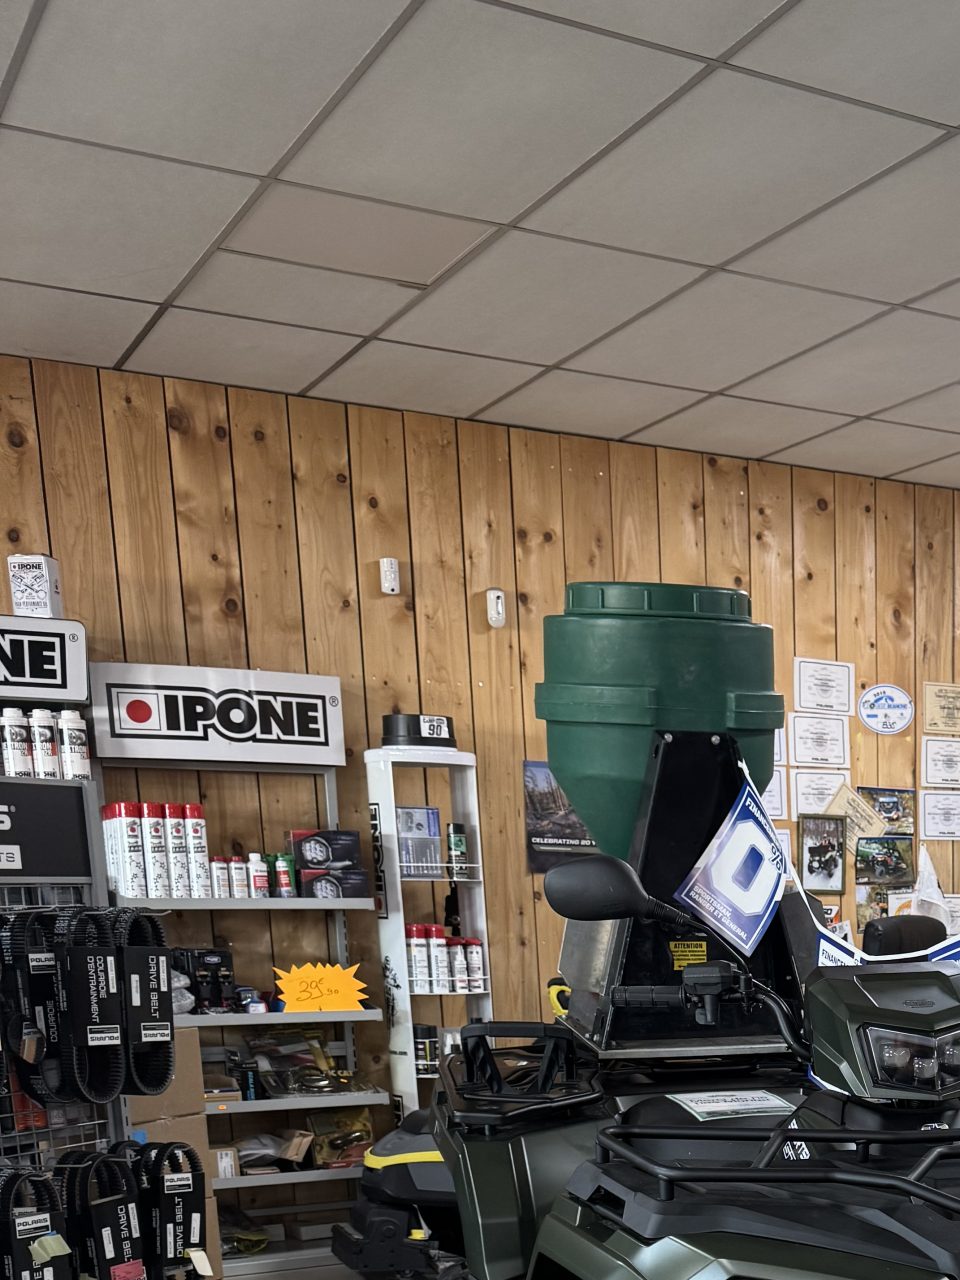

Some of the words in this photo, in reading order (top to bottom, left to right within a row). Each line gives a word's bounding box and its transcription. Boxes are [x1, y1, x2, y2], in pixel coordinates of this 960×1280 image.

[164, 694, 321, 739] IPONE
[428, 723, 443, 736] 90
[531, 837, 580, 845] CELEBRATING
[688, 891, 715, 913] RANGER
[713, 907, 723, 918] ET
[720, 913, 748, 941] GENERAL
[691, 884, 732, 920] SPORTSMAN,
[96, 955, 107, 999] COURROIE
[148, 955, 158, 989] DRIVE
[46, 1000, 58, 1042] COURROIE
[150, 992, 160, 1019] BELT
[165, 1176, 191, 1184] POLARIS
[17, 1217, 48, 1228] POLARIS
[117, 1205, 130, 1238] DRIVE
[175, 1196, 183, 1223] BELT
[121, 1240, 134, 1263] BEL
[176, 1225, 184, 1257] DRIVE
